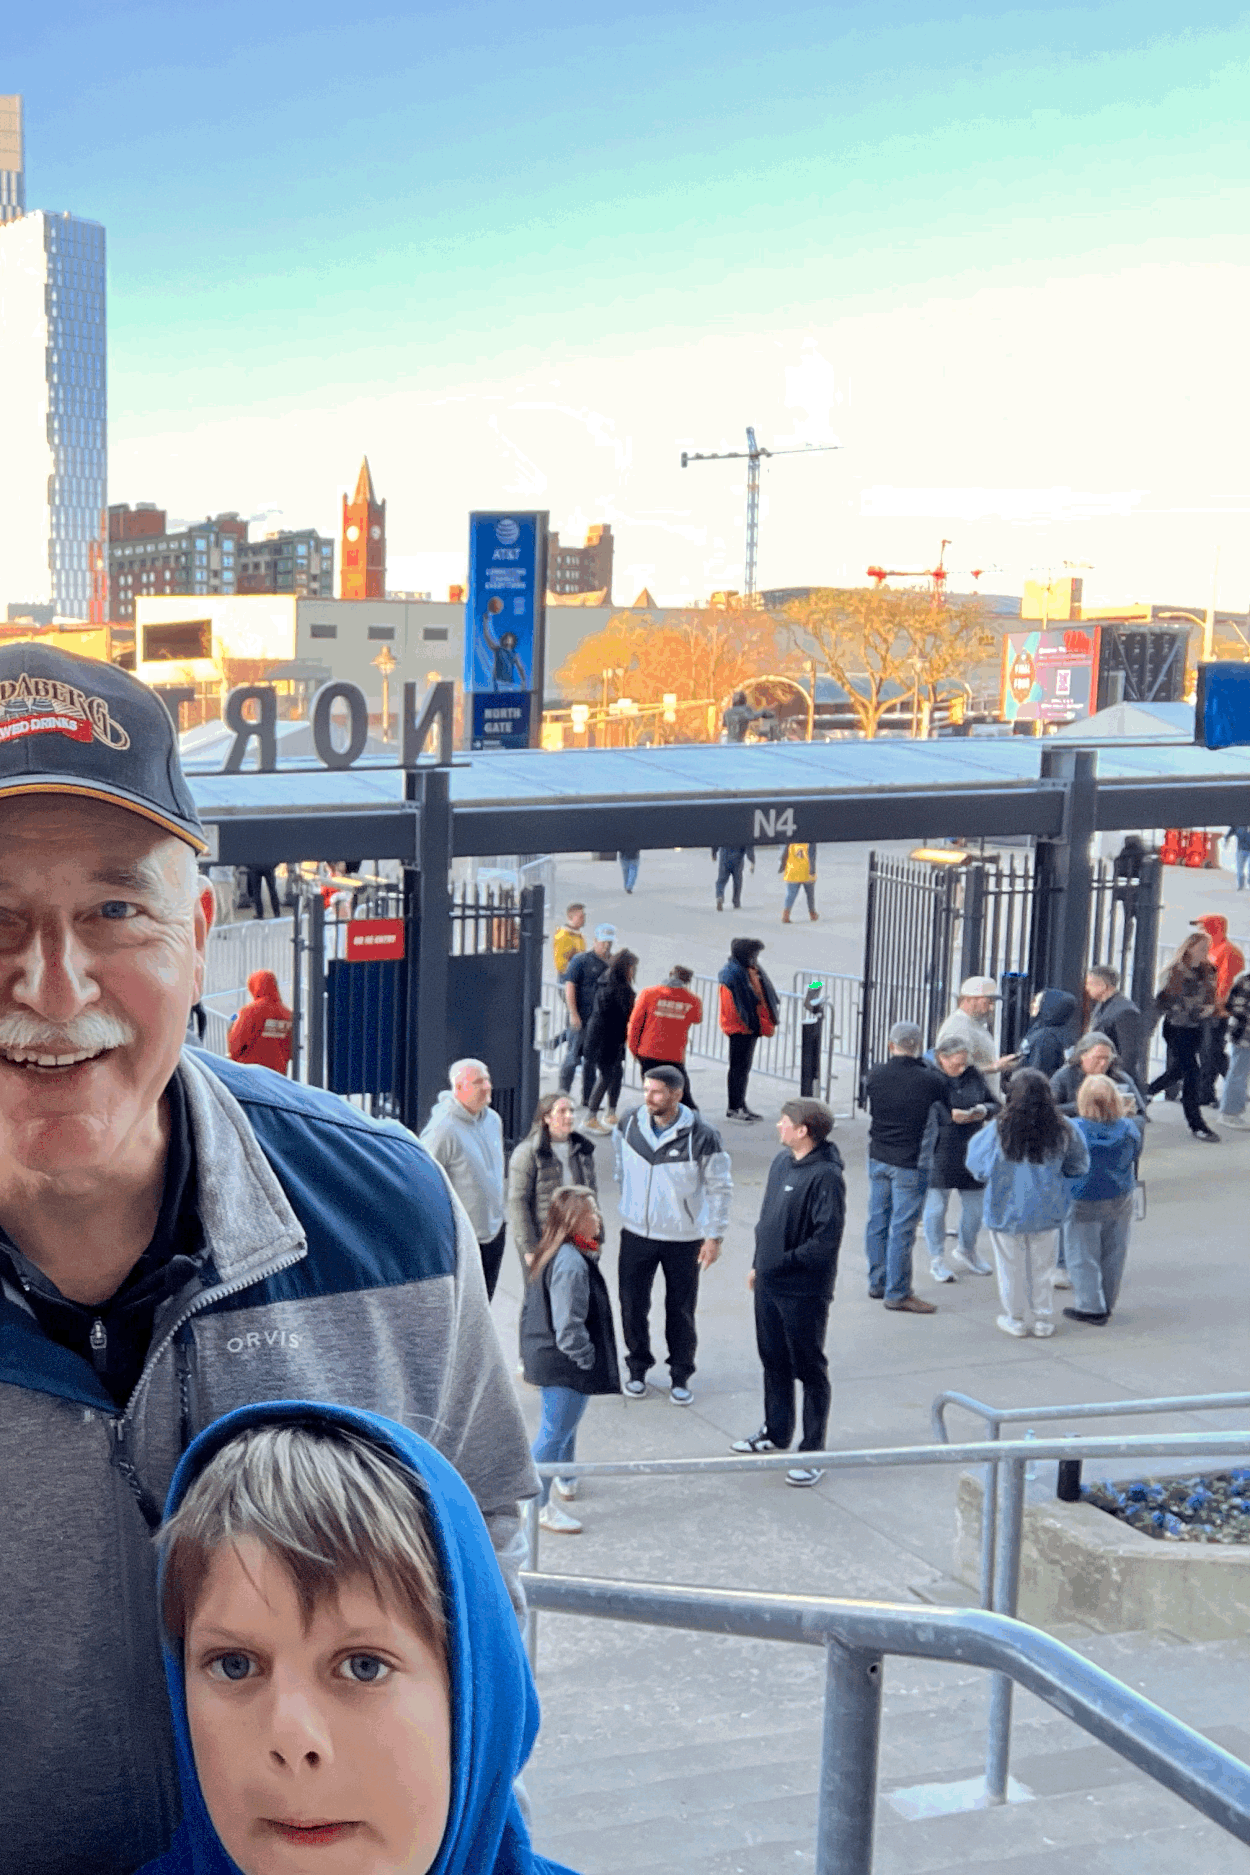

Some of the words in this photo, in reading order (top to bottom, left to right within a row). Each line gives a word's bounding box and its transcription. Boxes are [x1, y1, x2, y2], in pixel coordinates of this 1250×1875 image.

[484, 707, 522, 719] NORTH
[30, 717, 78, 731] DRINKS
[484, 721, 513, 734] GATE
[753, 808, 797, 838] N4
[227, 1330, 300, 1353] ORVIS
